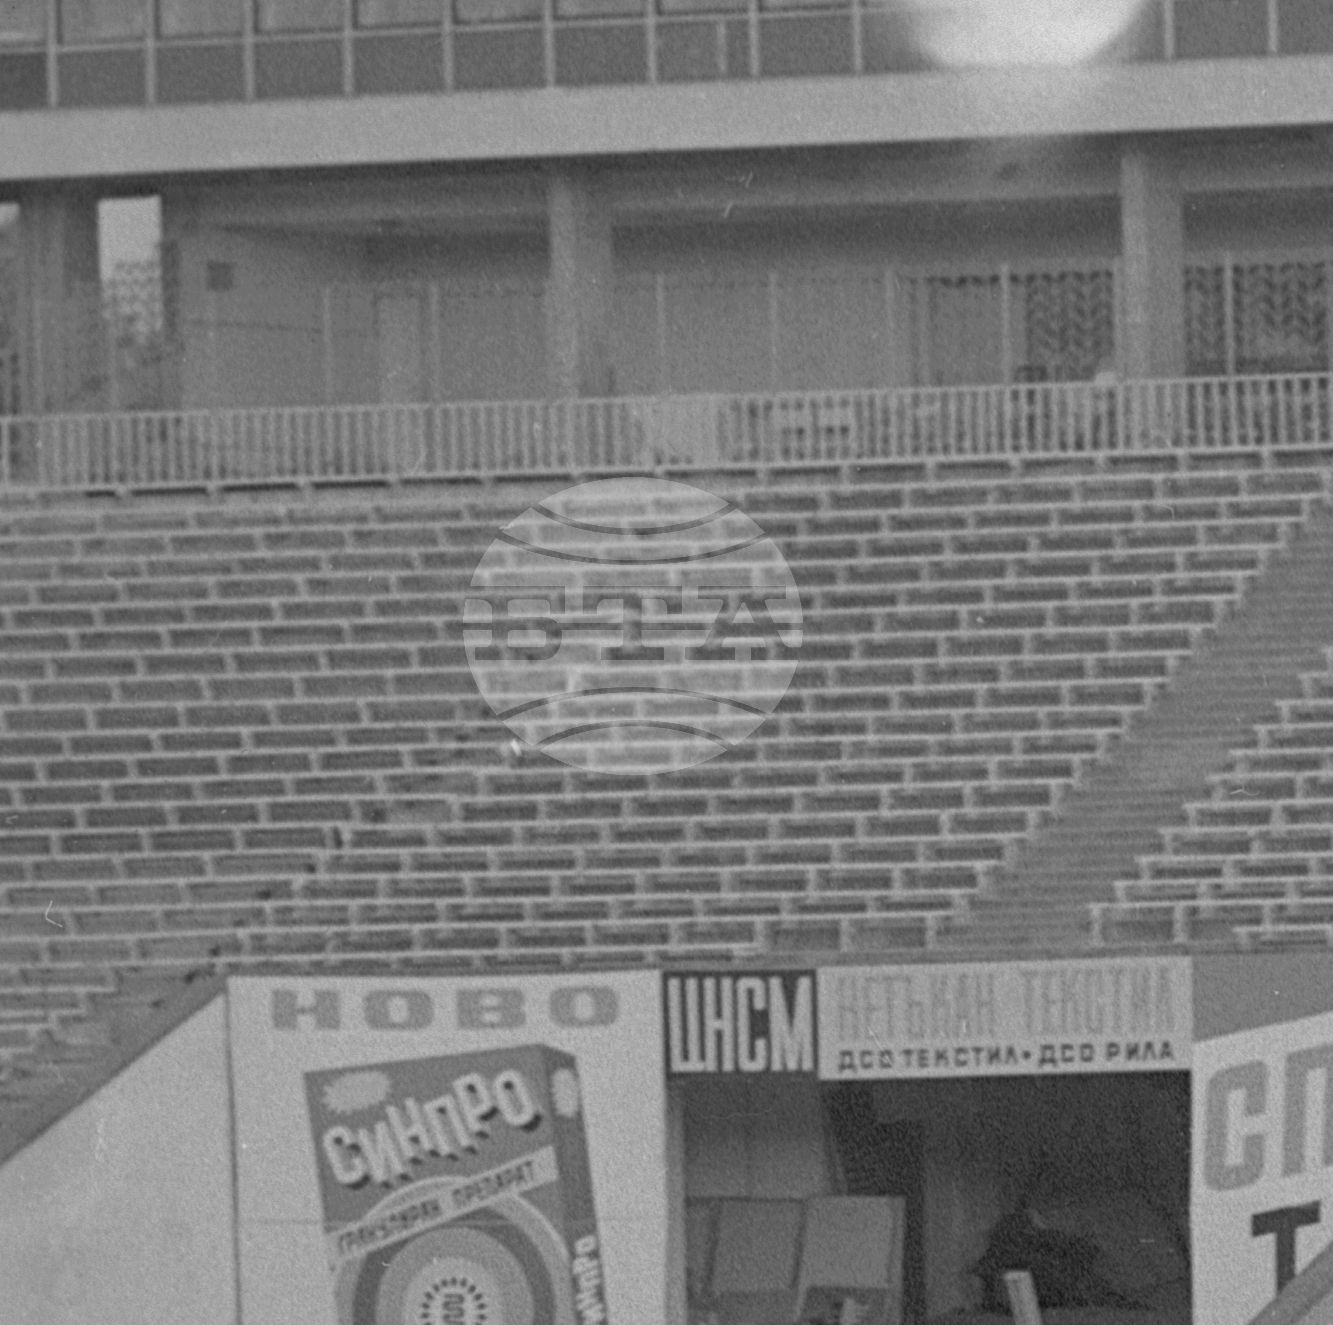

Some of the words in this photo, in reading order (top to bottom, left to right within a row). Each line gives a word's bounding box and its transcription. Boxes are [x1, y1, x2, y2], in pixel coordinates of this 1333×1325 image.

[271, 985, 619, 1031] НОВО
[838, 1048, 894, 1074] ДСО
[1036, 1042, 1096, 1069] ДСО
[1105, 1038, 1176, 1063] РИЛА
